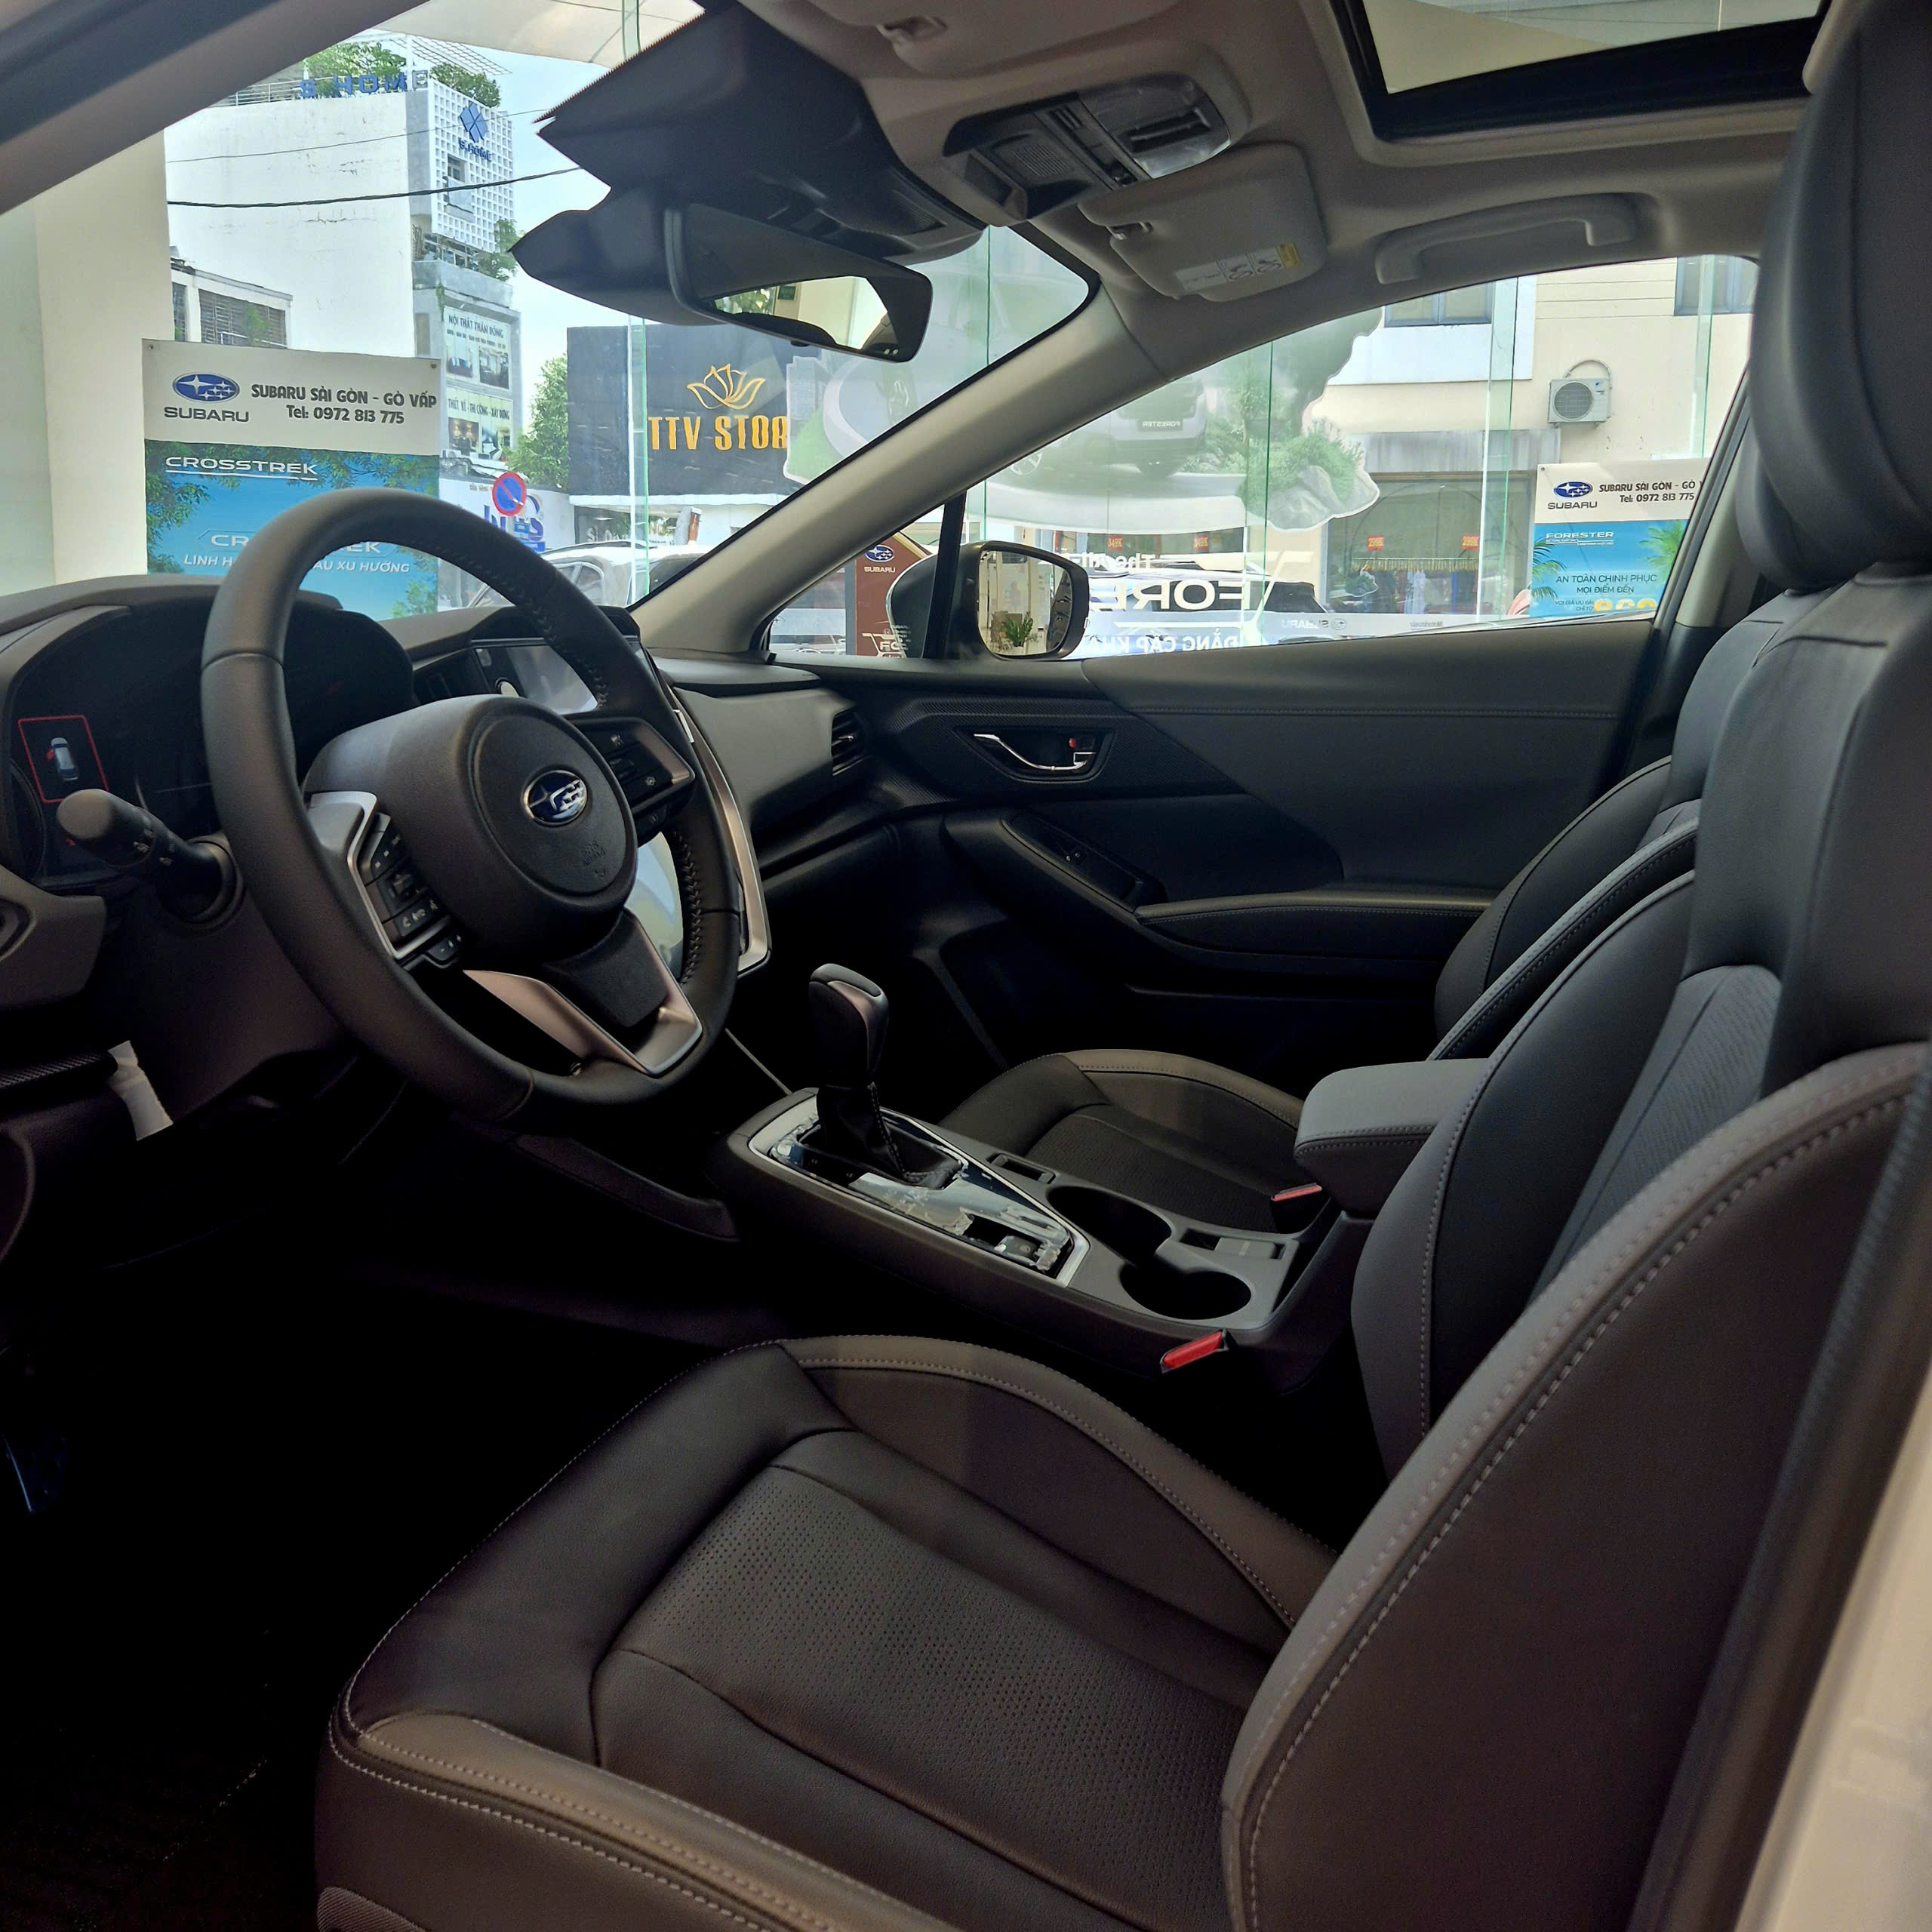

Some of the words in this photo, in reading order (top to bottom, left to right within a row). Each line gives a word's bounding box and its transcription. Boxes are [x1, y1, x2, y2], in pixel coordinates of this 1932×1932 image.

[251, 383, 306, 401] SUBARU
[310, 386, 332, 402] SÀI
[337, 388, 368, 404] GÒN
[383, 391, 405, 407] GÒ
[409, 390, 437, 408] VẤP
[164, 406, 250, 423] SUBARU
[286, 405, 309, 419] Tel:
[313, 406, 350, 421] 0972
[354, 409, 376, 423] 813
[380, 410, 405, 424] 775
[648, 416, 701, 451] TTV
[715, 414, 787, 451] STOR
[165, 457, 318, 475] CROSSTREK
[1599, 483, 1633, 493] SUBARU
[1635, 482, 1649, 491] SÀI
[1652, 481, 1672, 491] GÒN
[1620, 494, 1633, 503] Tel:
[1636, 494, 1659, 502] 0972
[1662, 493, 1675, 501] 813
[1679, 492, 1694, 500] 775
[1547, 501, 1598, 509] SUBARU
[183, 555, 218, 566] LINH
[337, 561, 356, 571] XU
[1571, 574, 1596, 583] TOÀN
[1598, 574, 1628, 583] CHINH
[1631, 574, 1657, 584] PHỤC
[1577, 586, 1592, 595] MỌI
[1594, 583, 1614, 593] ĐIỂM
[1617, 584, 1634, 593] ĐẾN
